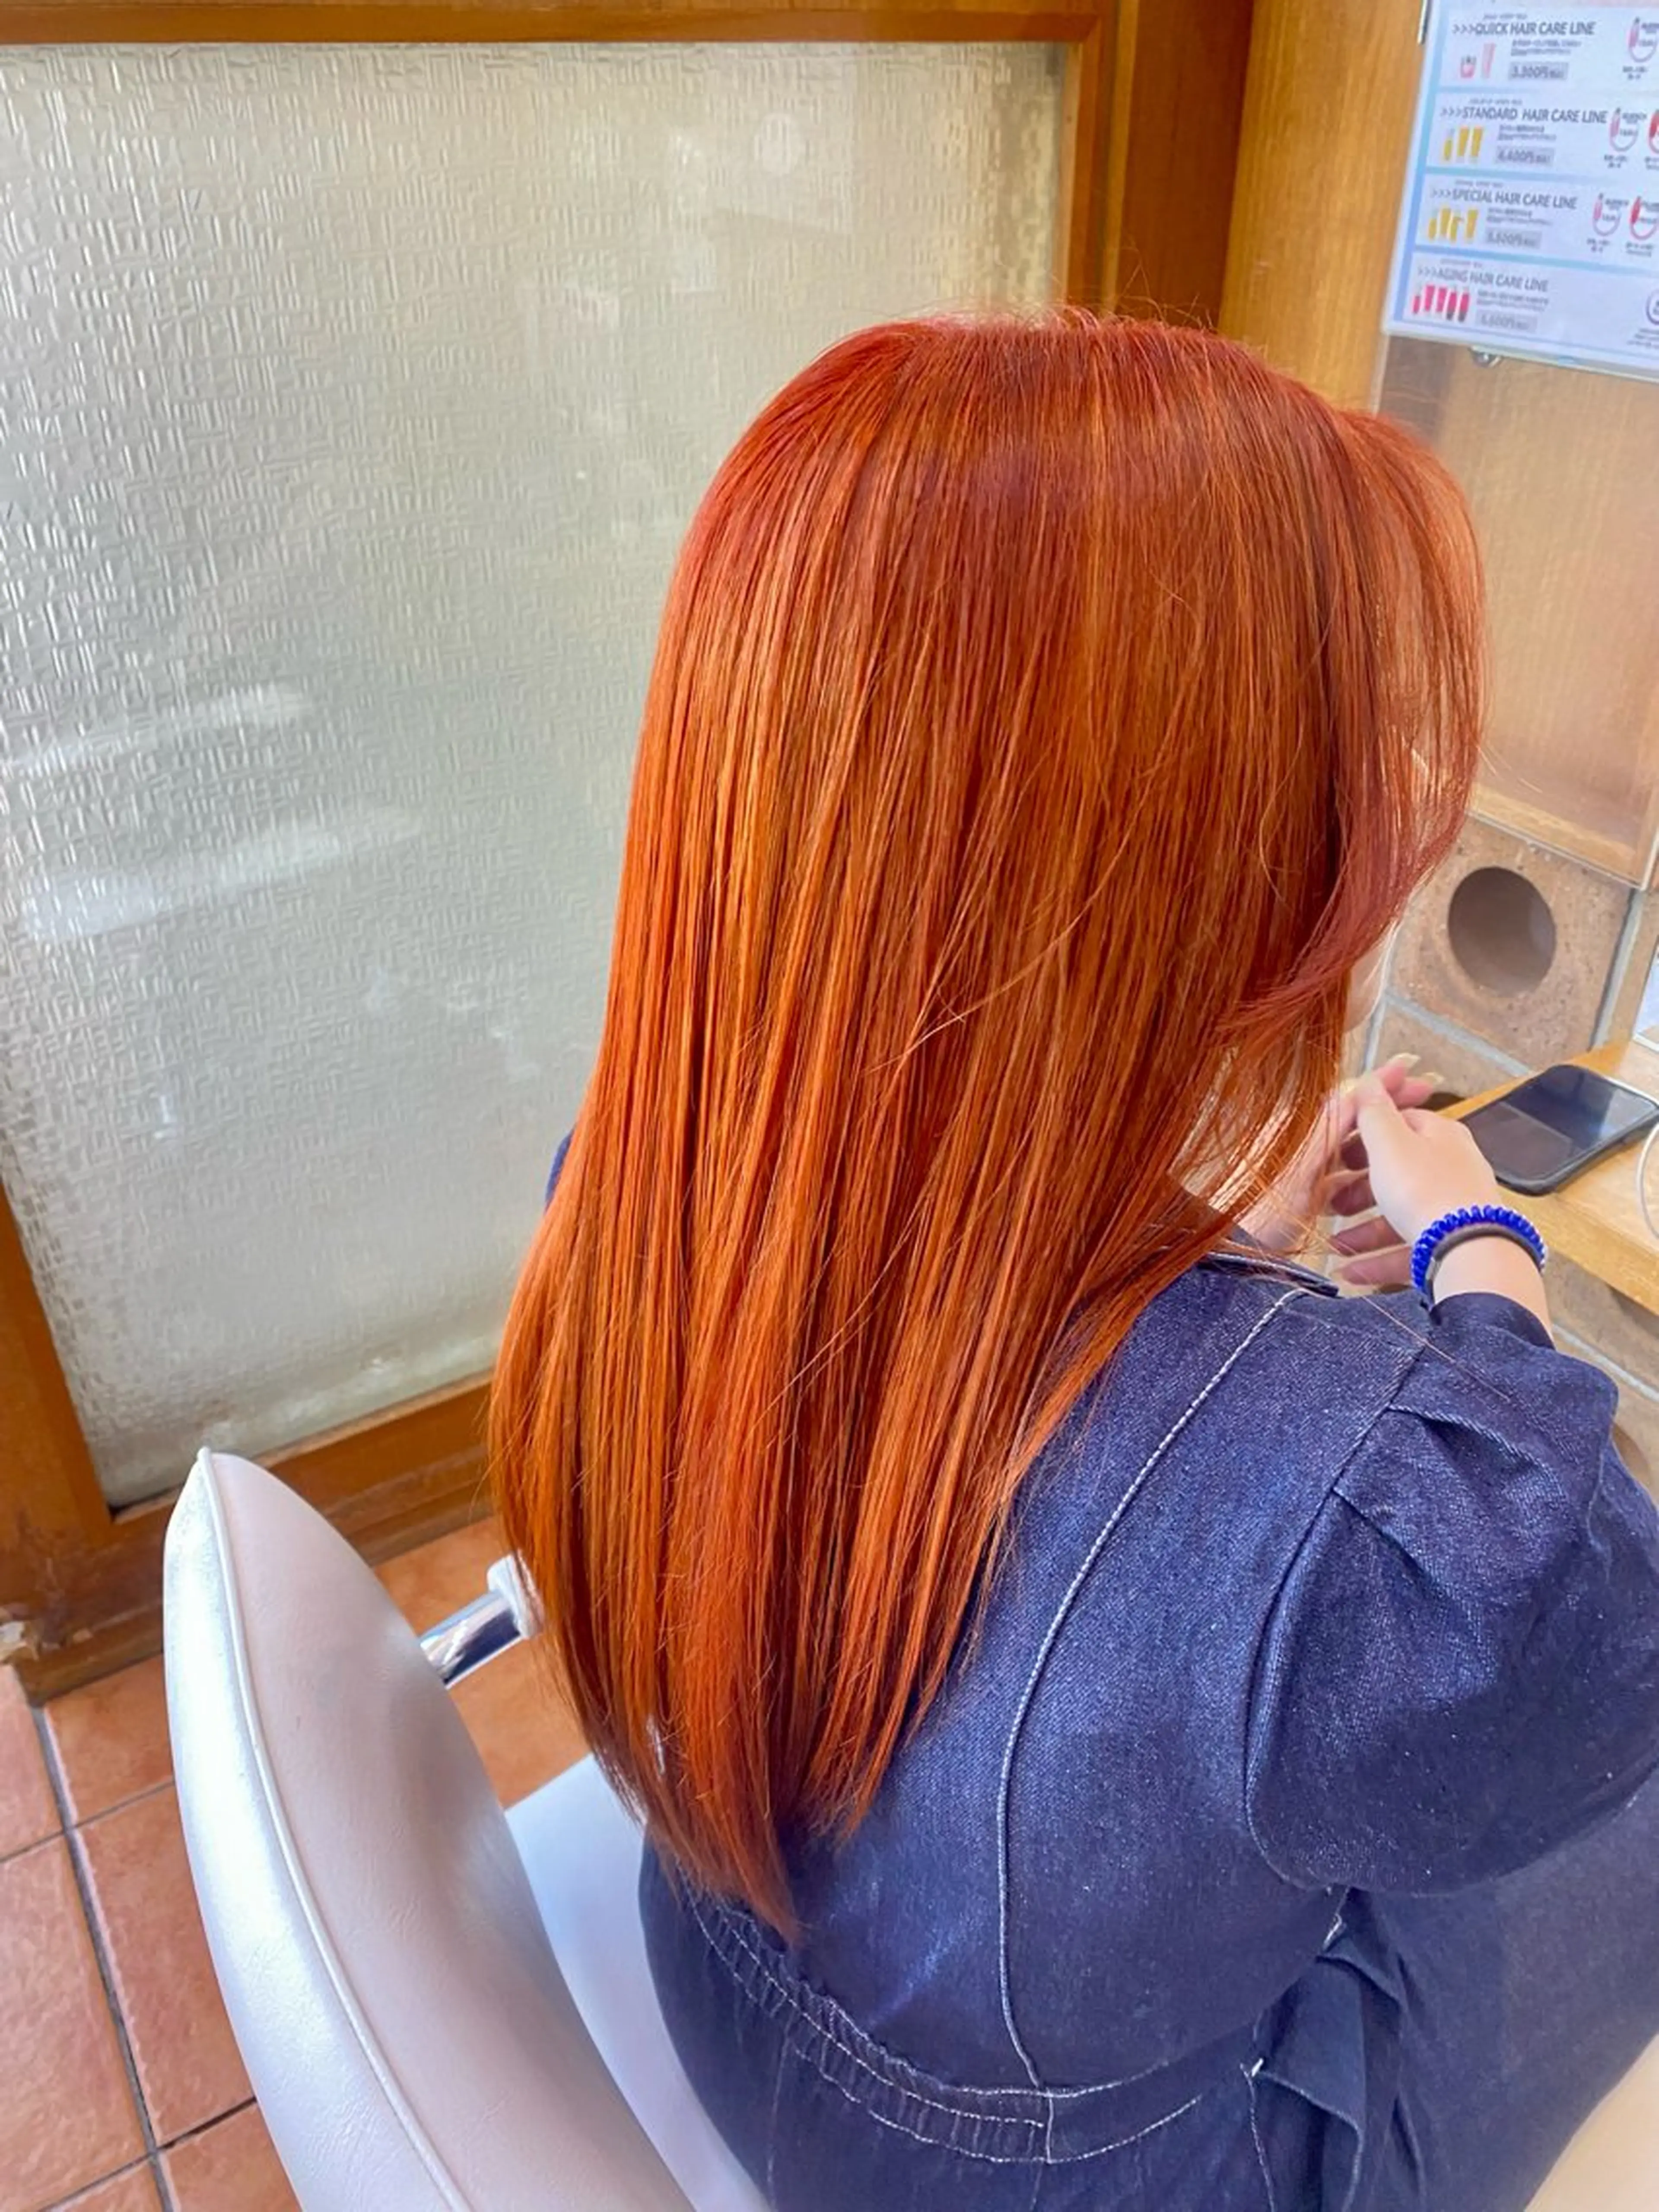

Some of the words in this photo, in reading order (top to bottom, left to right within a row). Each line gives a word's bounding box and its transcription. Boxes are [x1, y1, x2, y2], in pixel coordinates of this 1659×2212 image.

[1475, 22, 1508, 36] QUICK
[1510, 22, 1537, 35] HAIR
[1539, 21, 1568, 35] CARE
[1569, 21, 1596, 35] LINE
[1463, 107, 1518, 121] STANDARD
[1522, 108, 1549, 121] HAIR
[1551, 109, 1580, 122] CARE
[1582, 110, 1608, 124] LINE
[1452, 189, 1492, 203] SPECIAL
[1495, 191, 1521, 205] HAIR
[1522, 193, 1551, 207] CARE
[1553, 195, 1578, 210] LINE
[1469, 270, 1494, 285] HAIR
[1495, 273, 1523, 289] CARE
[1524, 276, 1549, 292] LINE
